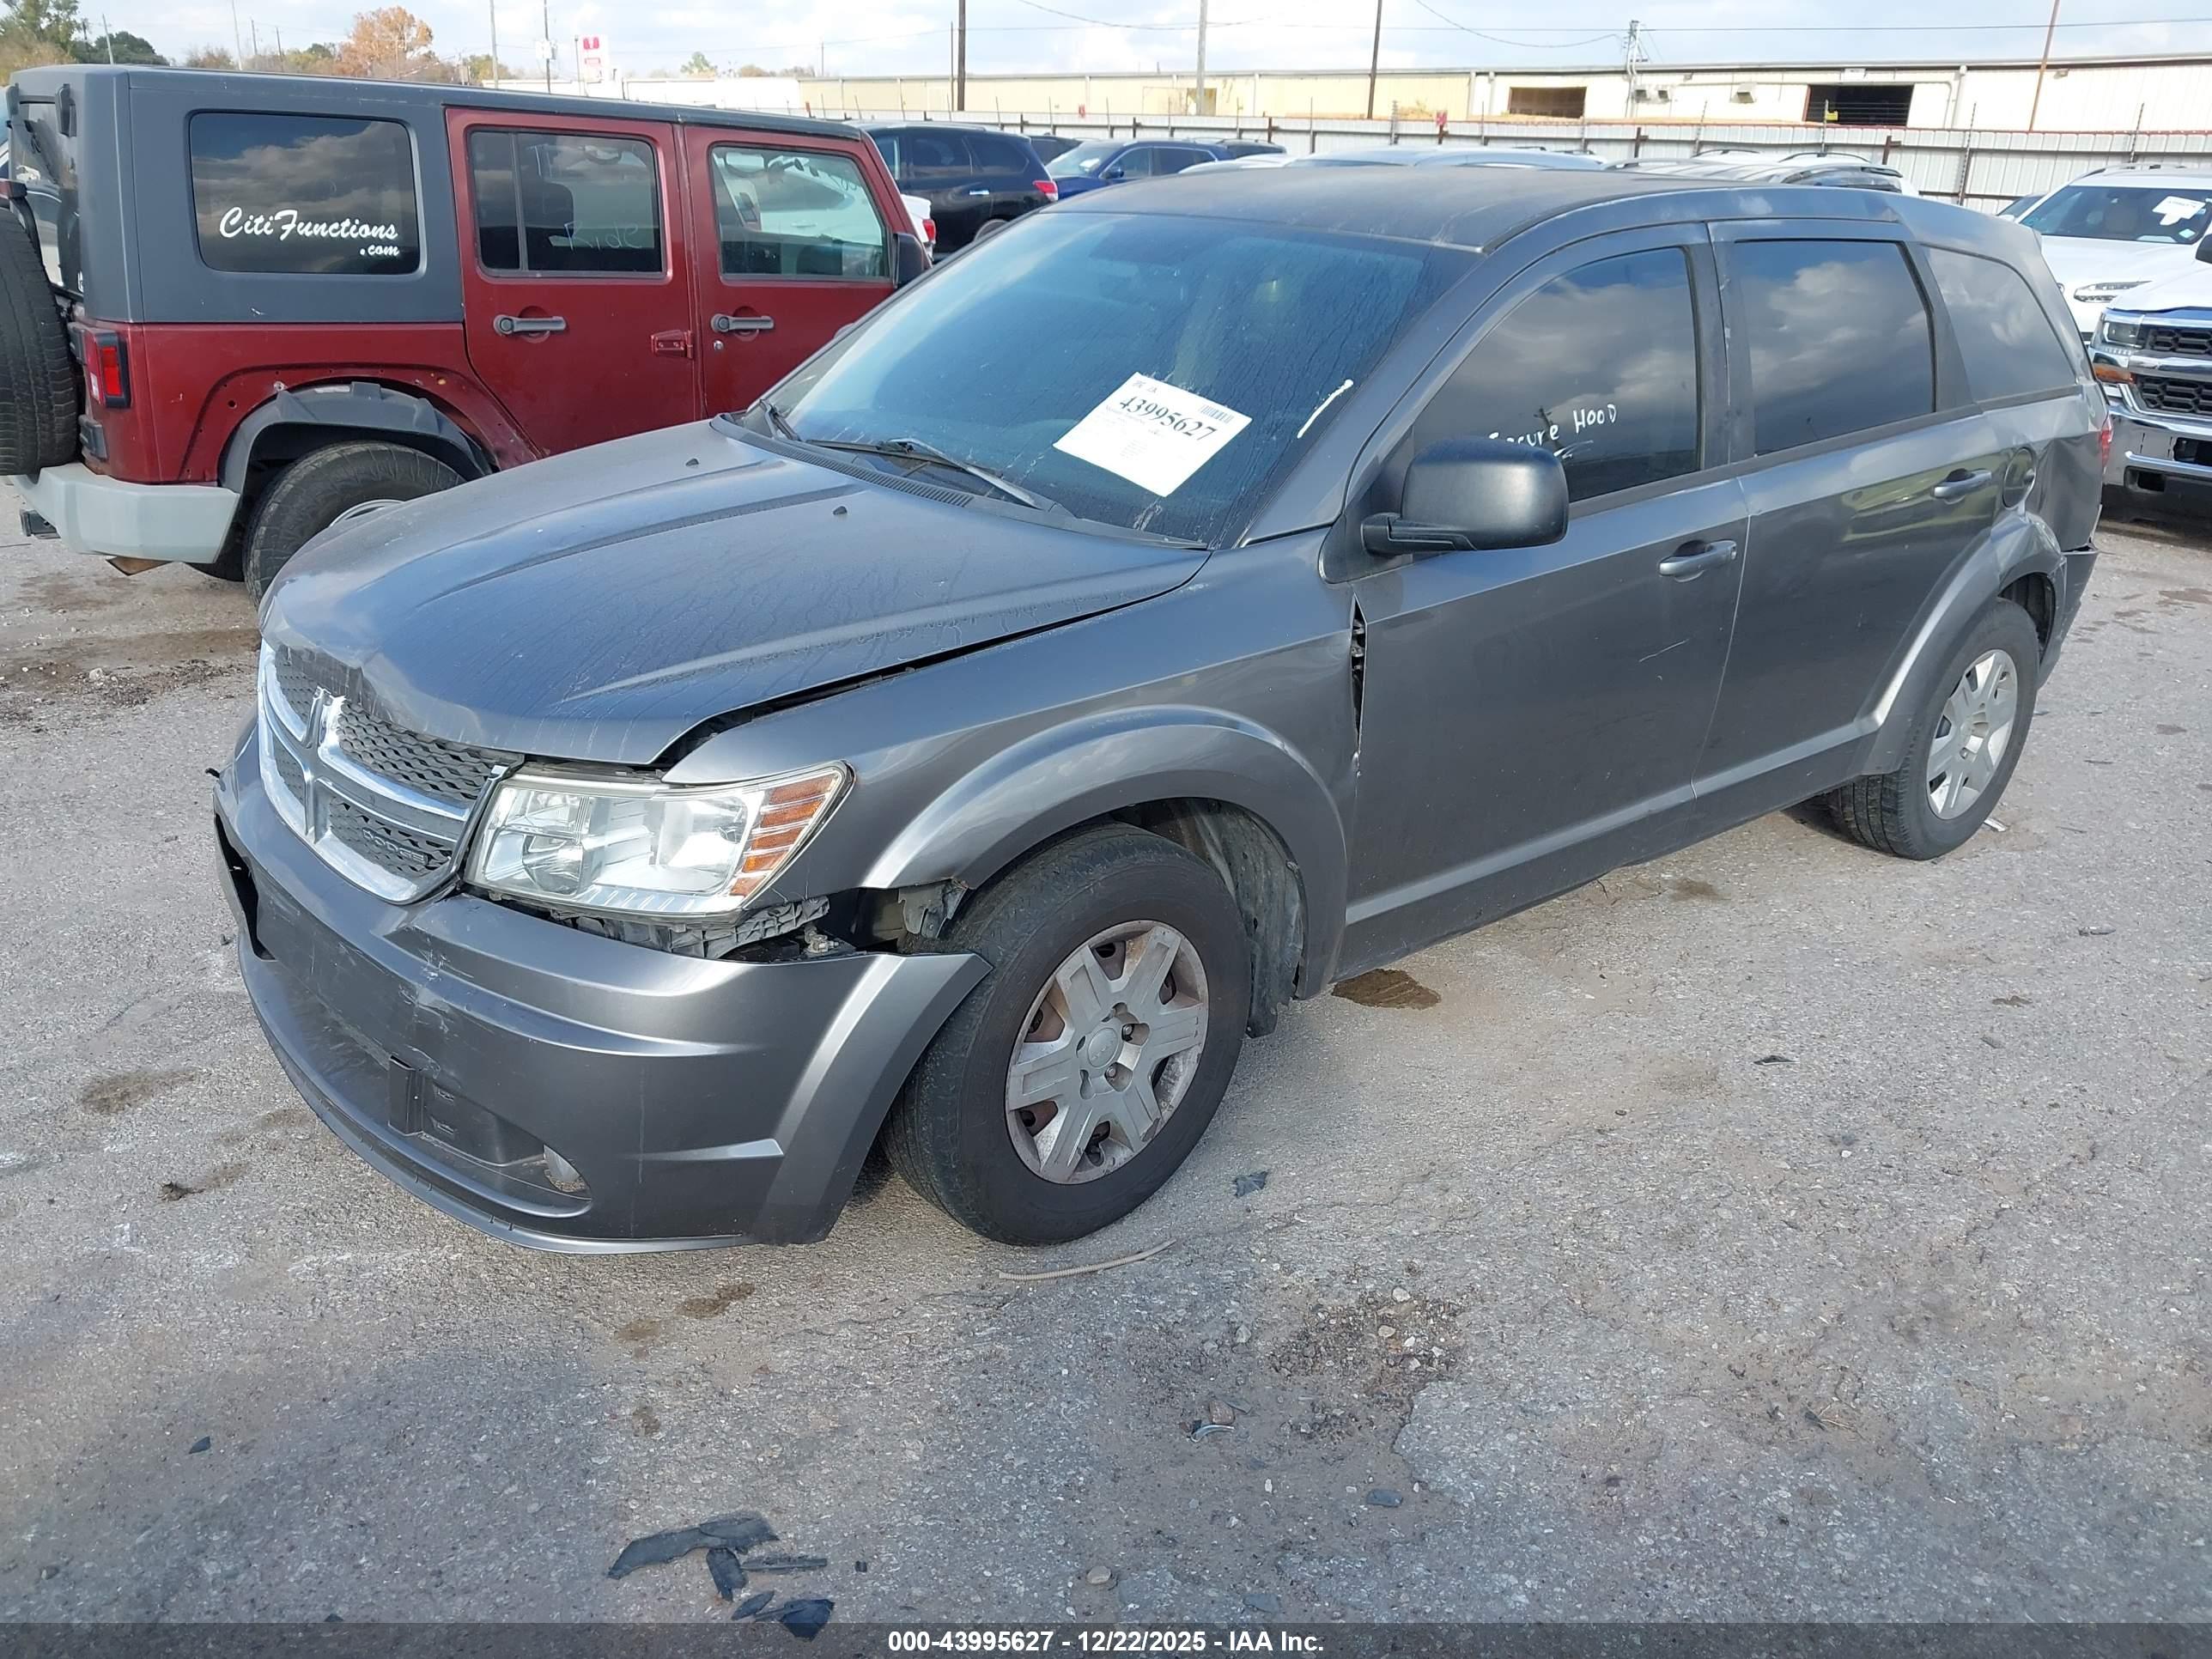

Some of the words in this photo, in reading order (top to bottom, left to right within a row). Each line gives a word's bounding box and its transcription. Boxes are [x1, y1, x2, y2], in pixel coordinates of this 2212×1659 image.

[219, 206, 398, 240] CitiFunctions
[360, 244, 399, 256] .com
[1119, 396, 1218, 441] 43995627
[1489, 424, 1560, 447] cure
[362, 829, 426, 864] DODGE
